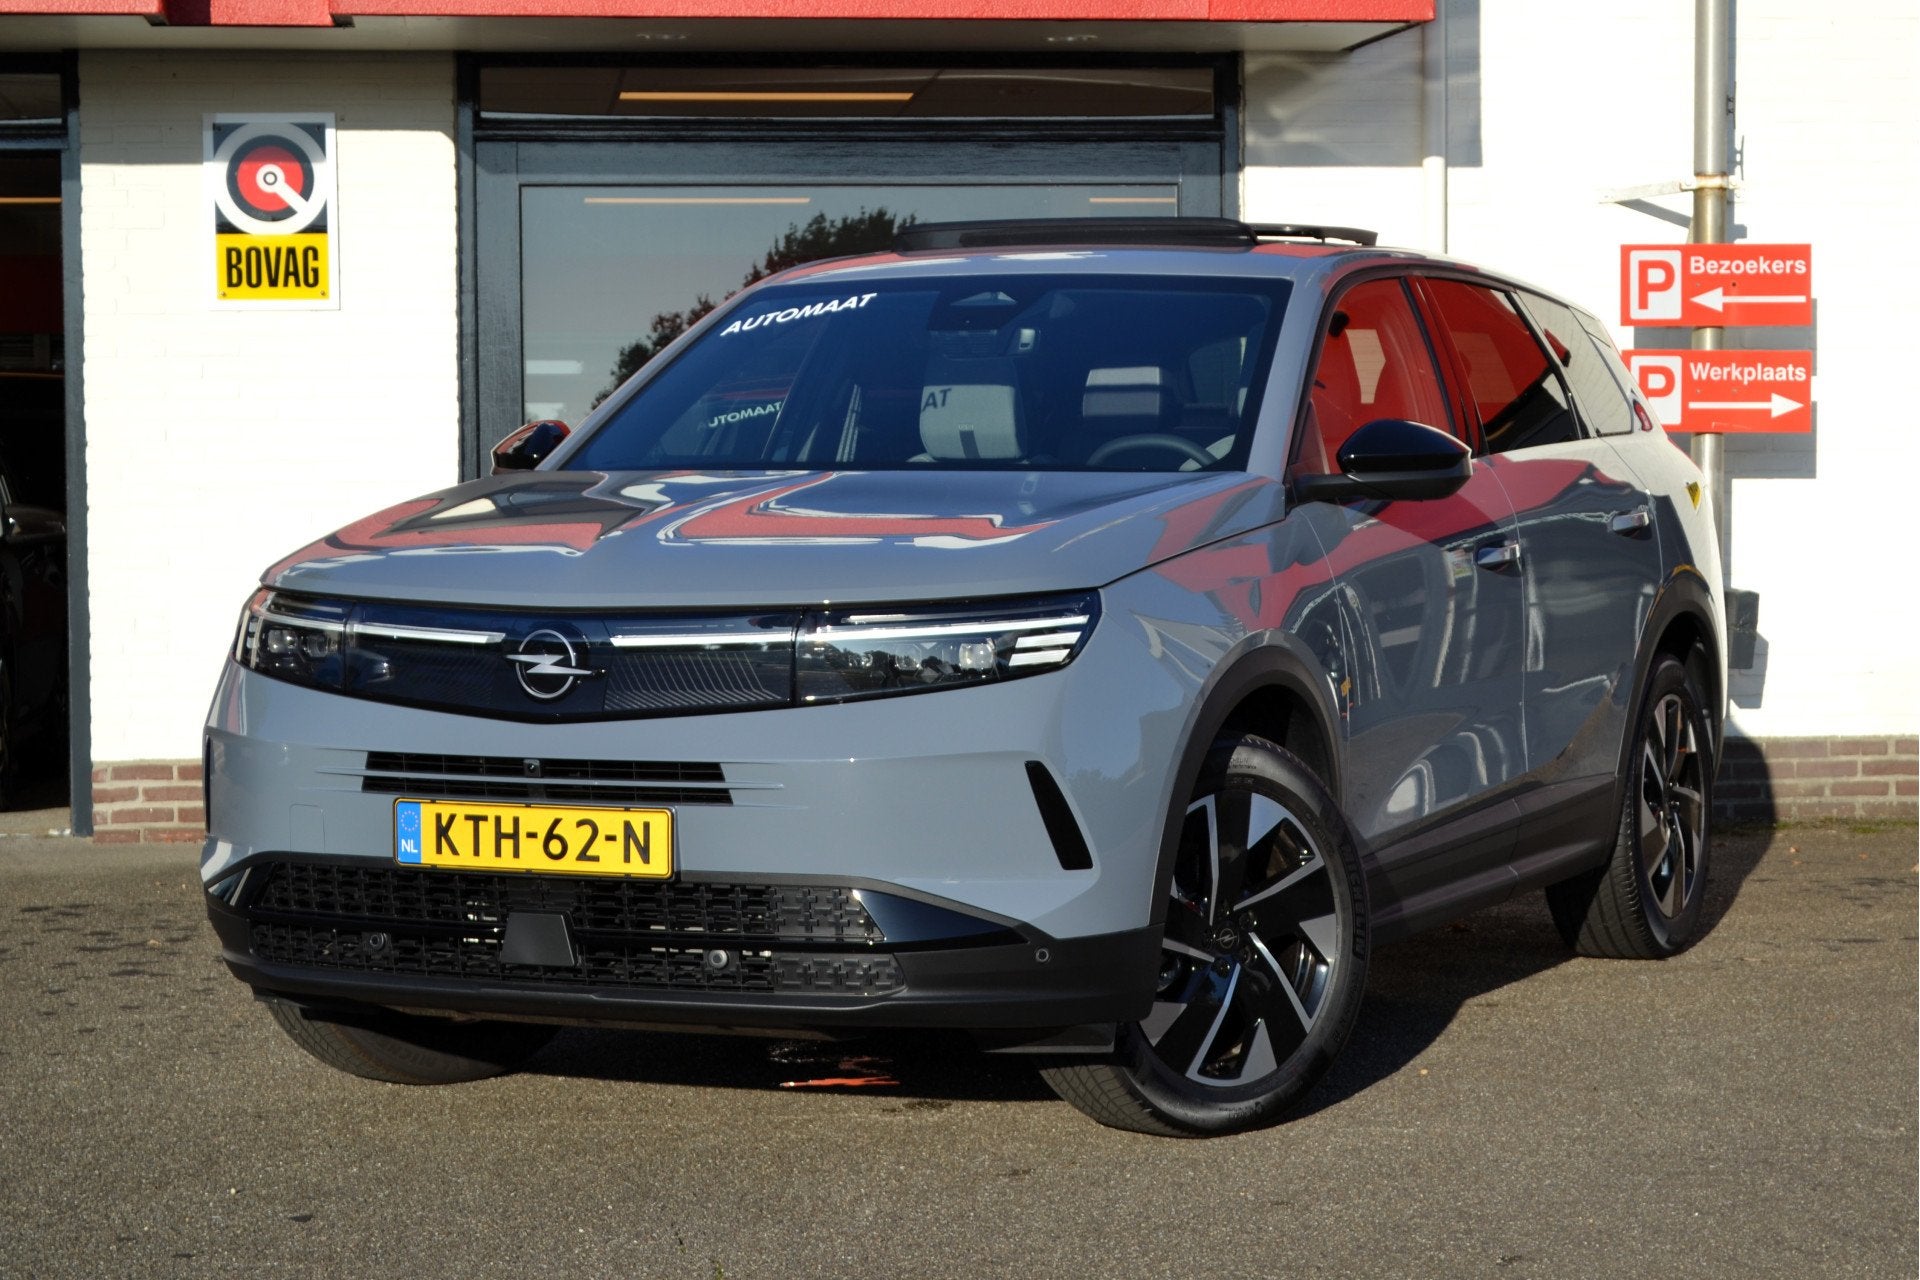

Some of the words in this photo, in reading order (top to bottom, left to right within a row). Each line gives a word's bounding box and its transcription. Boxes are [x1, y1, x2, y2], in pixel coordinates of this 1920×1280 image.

[226, 246, 319, 288] BOVAG
[1638, 260, 1675, 310] P
[1690, 256, 1806, 274] Bezoekers
[720, 293, 877, 336] AUTOMAAT
[1690, 362, 1806, 386] Werkplaats
[401, 838, 418, 854] NL
[435, 812, 650, 865] KTH-62-N
